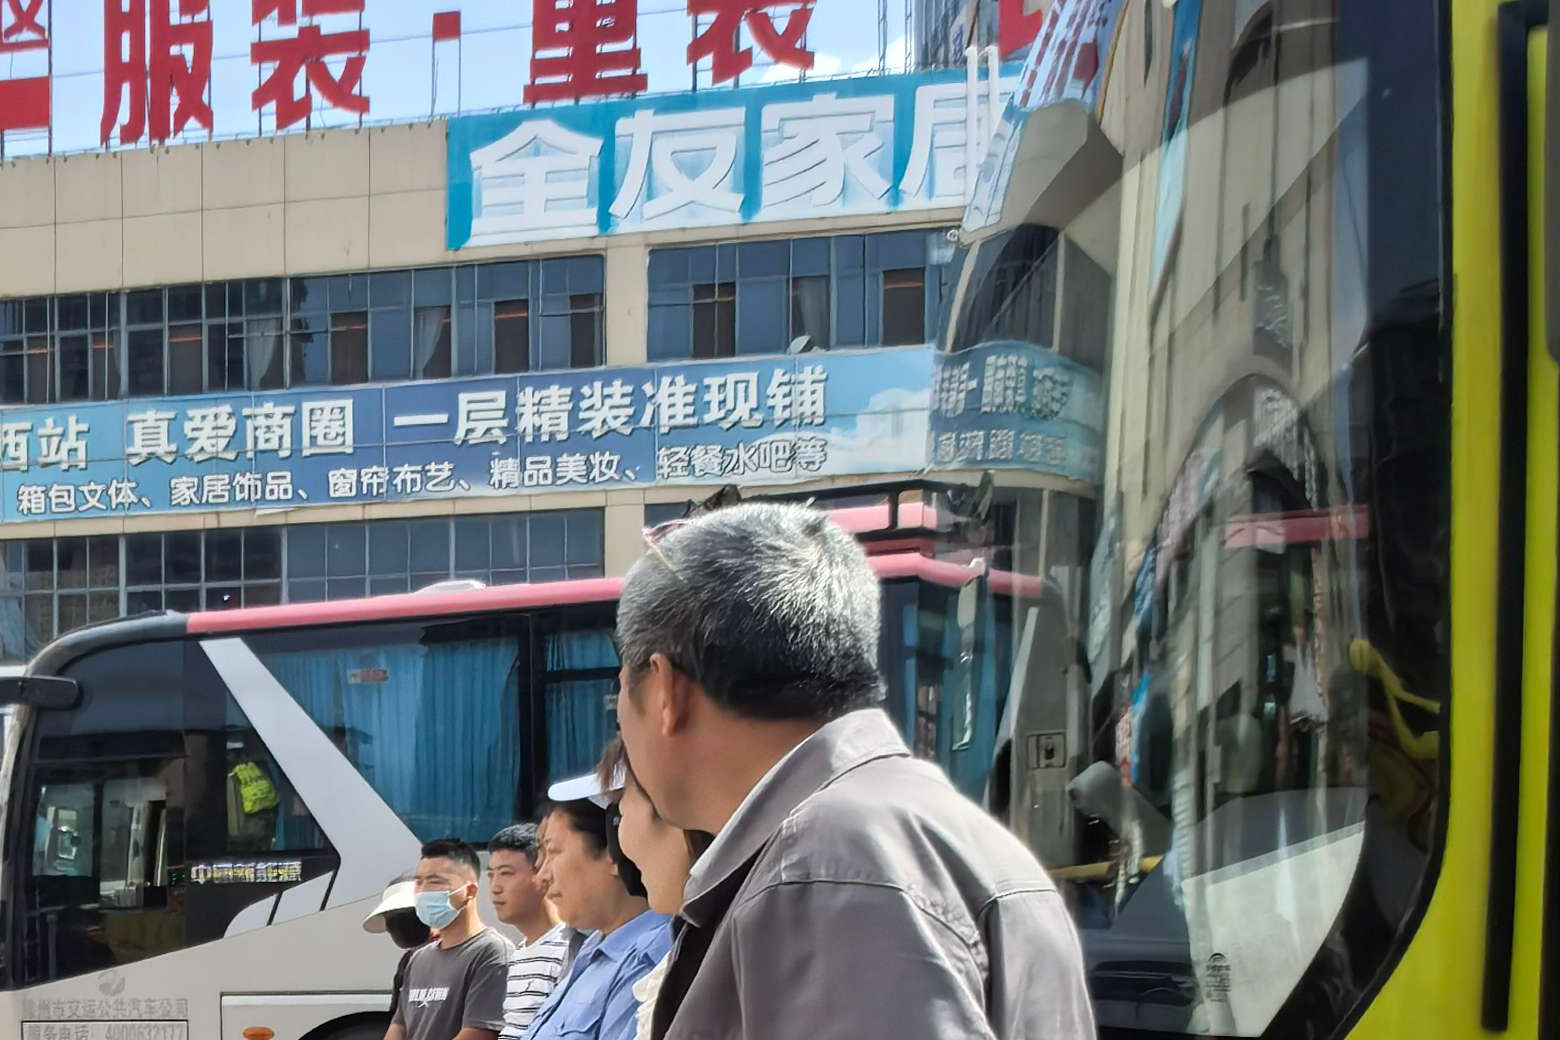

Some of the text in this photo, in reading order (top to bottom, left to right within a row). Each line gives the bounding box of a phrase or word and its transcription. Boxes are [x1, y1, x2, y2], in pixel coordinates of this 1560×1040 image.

[125, 398, 354, 466] 真爱商圈
[393, 364, 828, 446] 一层精装准现铺
